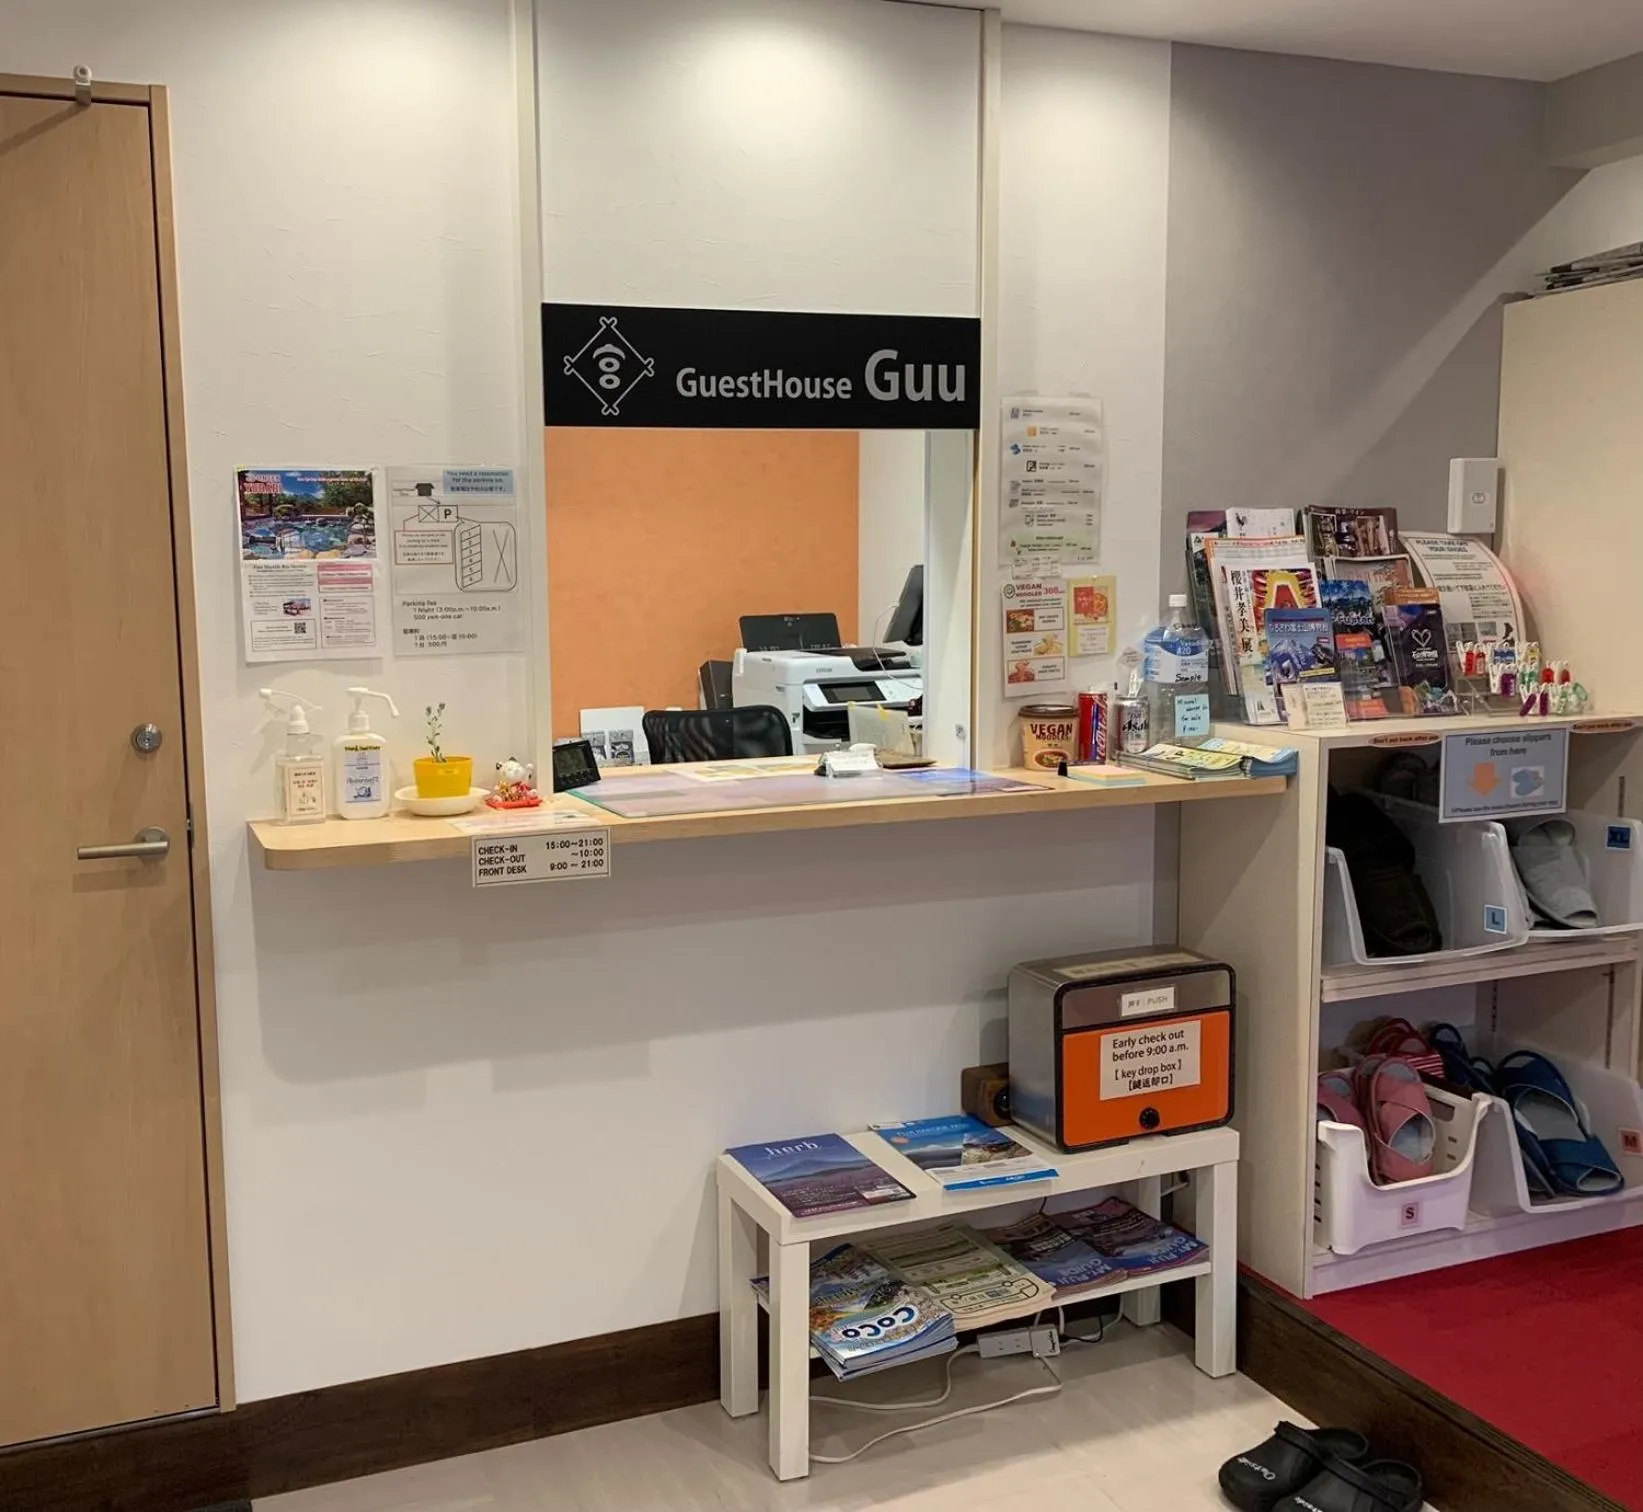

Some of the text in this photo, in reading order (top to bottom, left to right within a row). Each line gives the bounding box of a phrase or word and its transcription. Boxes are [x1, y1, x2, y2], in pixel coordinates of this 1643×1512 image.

[676, 348, 966, 402] GuestHouse Guu
[444, 508, 452, 519] P
[1016, 583, 1042, 591] VEGAN
[1175, 673, 1201, 683] Sample
[1030, 723, 1073, 734] VEGAN
[1465, 733, 1551, 746] Please choose slippers
[1489, 747, 1527, 756] from here
[478, 844, 518, 856] CHECK-IN
[478, 854, 526, 866] CHECK-OUT
[478, 867, 504, 877] FRONT
[506, 865, 527, 874] DESK
[550, 862, 568, 871] 9:00
[581, 859, 604, 869] 21:00
[1491, 911, 1500, 925] L
[1147, 996, 1168, 1006] PUSH
[1112, 1030, 1185, 1050] Early check out
[1112, 1044, 1189, 1062] before 9:00 a.m.
[1121, 1068, 1137, 1080] key
[1138, 1065, 1159, 1077] drop
[1160, 1062, 1176, 1072] box
[1624, 1134, 1638, 1148] M
[764, 1139, 819, 1157] herb
[1405, 1207, 1415, 1219] S
[1056, 1258, 1102, 1275] GUIDE
